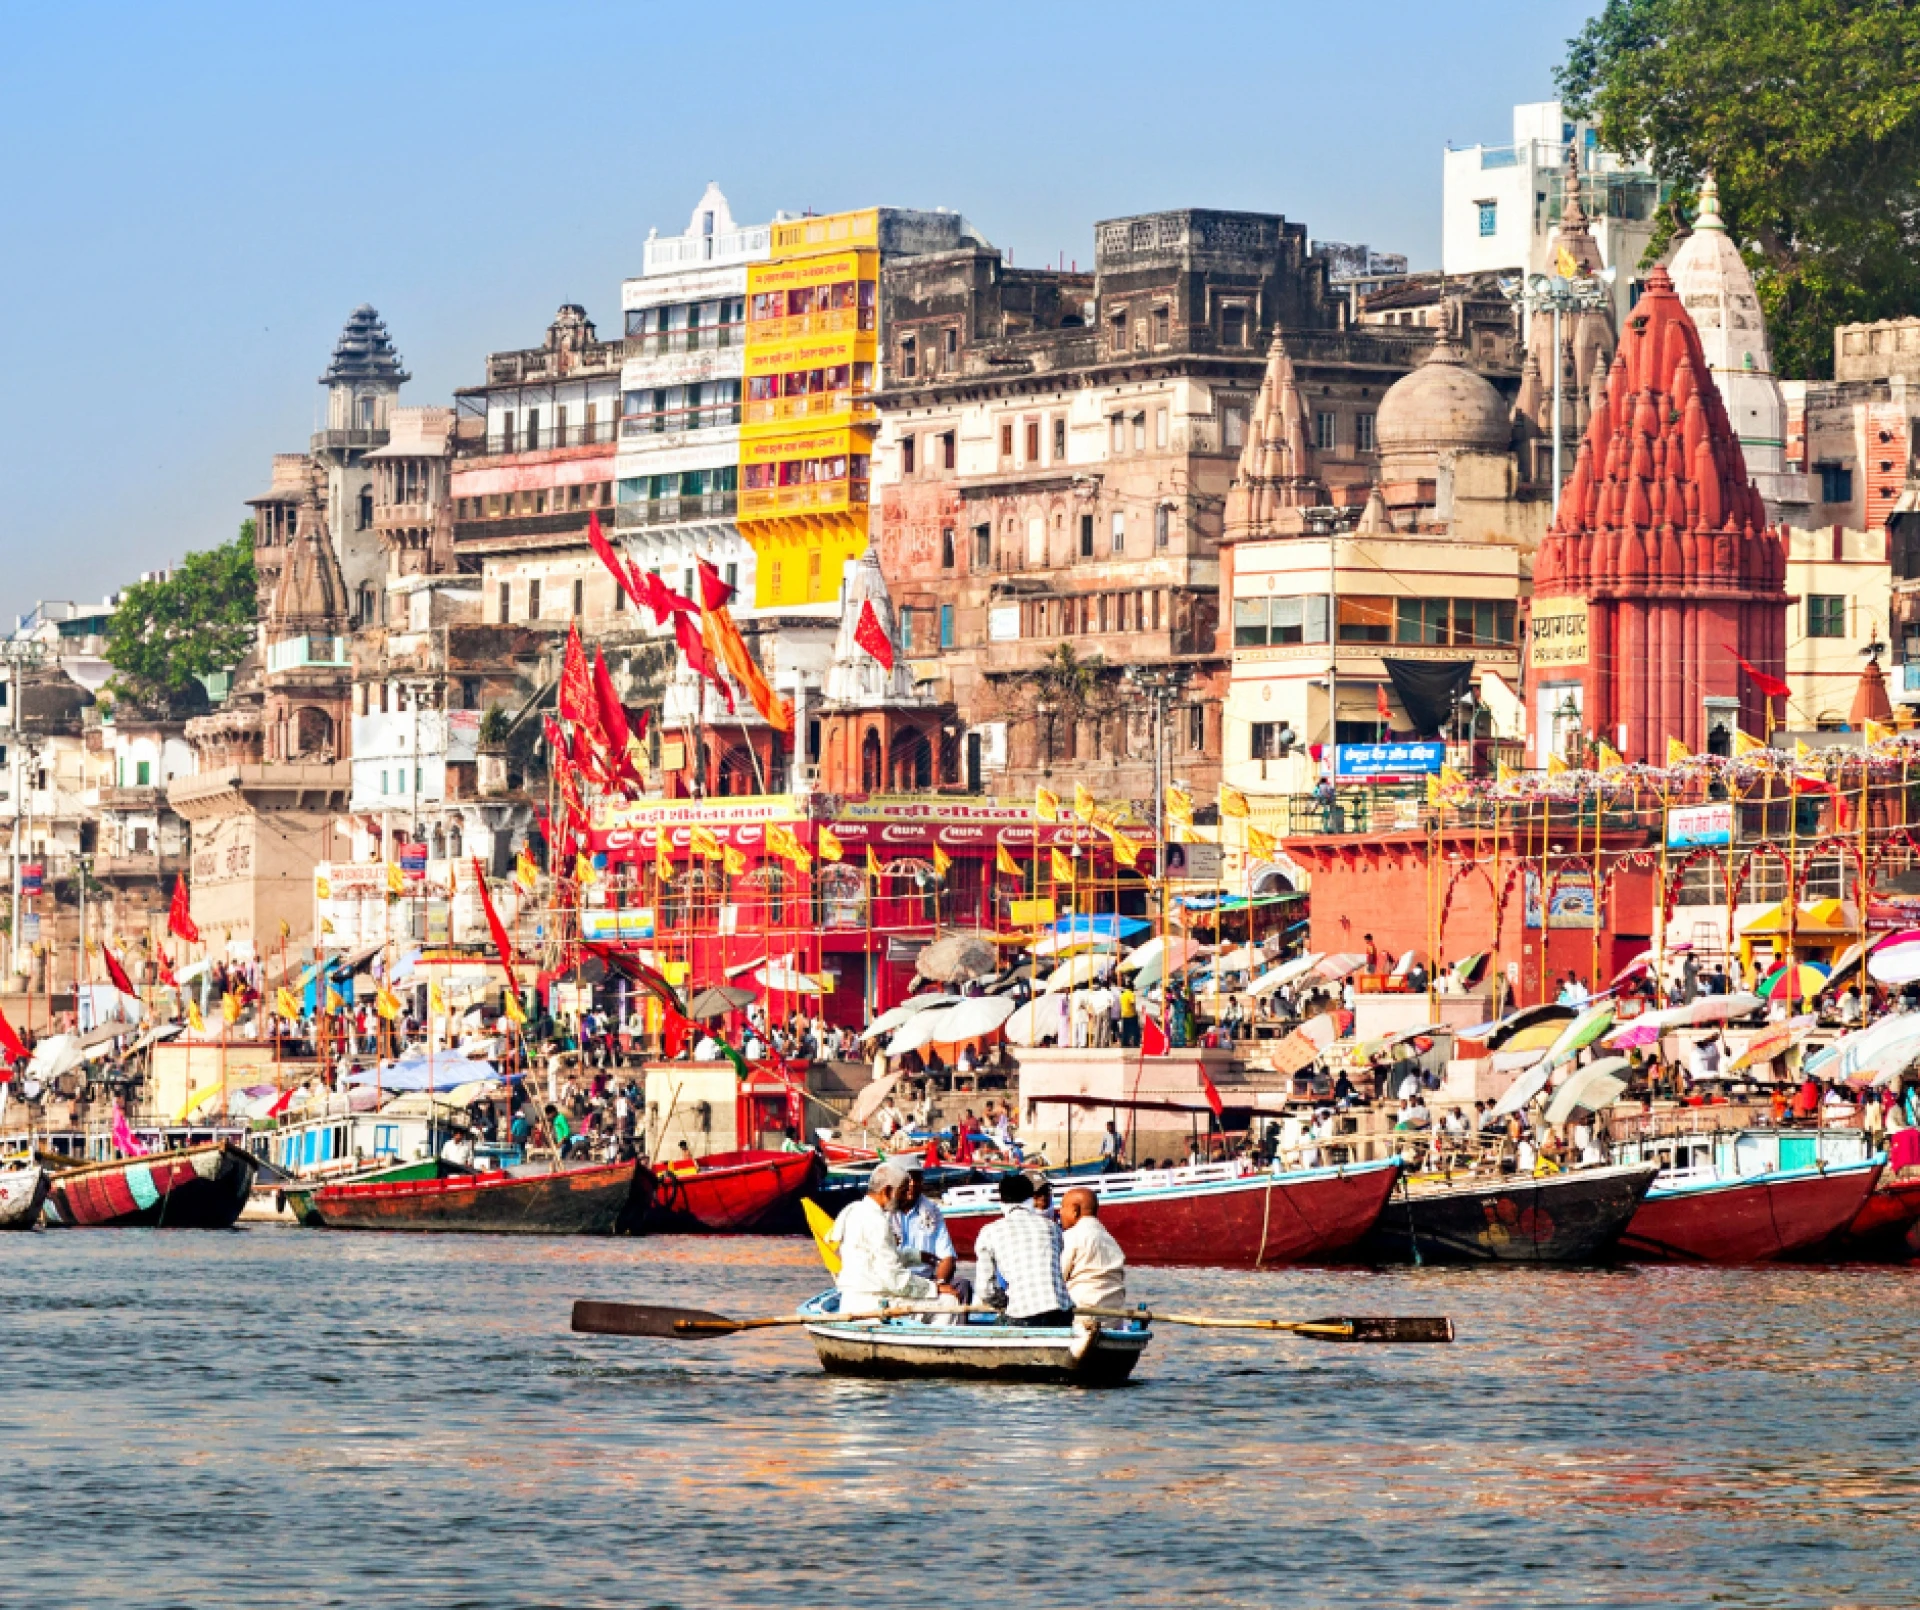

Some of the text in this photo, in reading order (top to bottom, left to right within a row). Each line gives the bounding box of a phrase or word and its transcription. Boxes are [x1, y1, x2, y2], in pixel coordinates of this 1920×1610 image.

[1567, 614, 1586, 636] घाट
[892, 825, 926, 835] RUPA
[950, 826, 983, 837] RUPA
